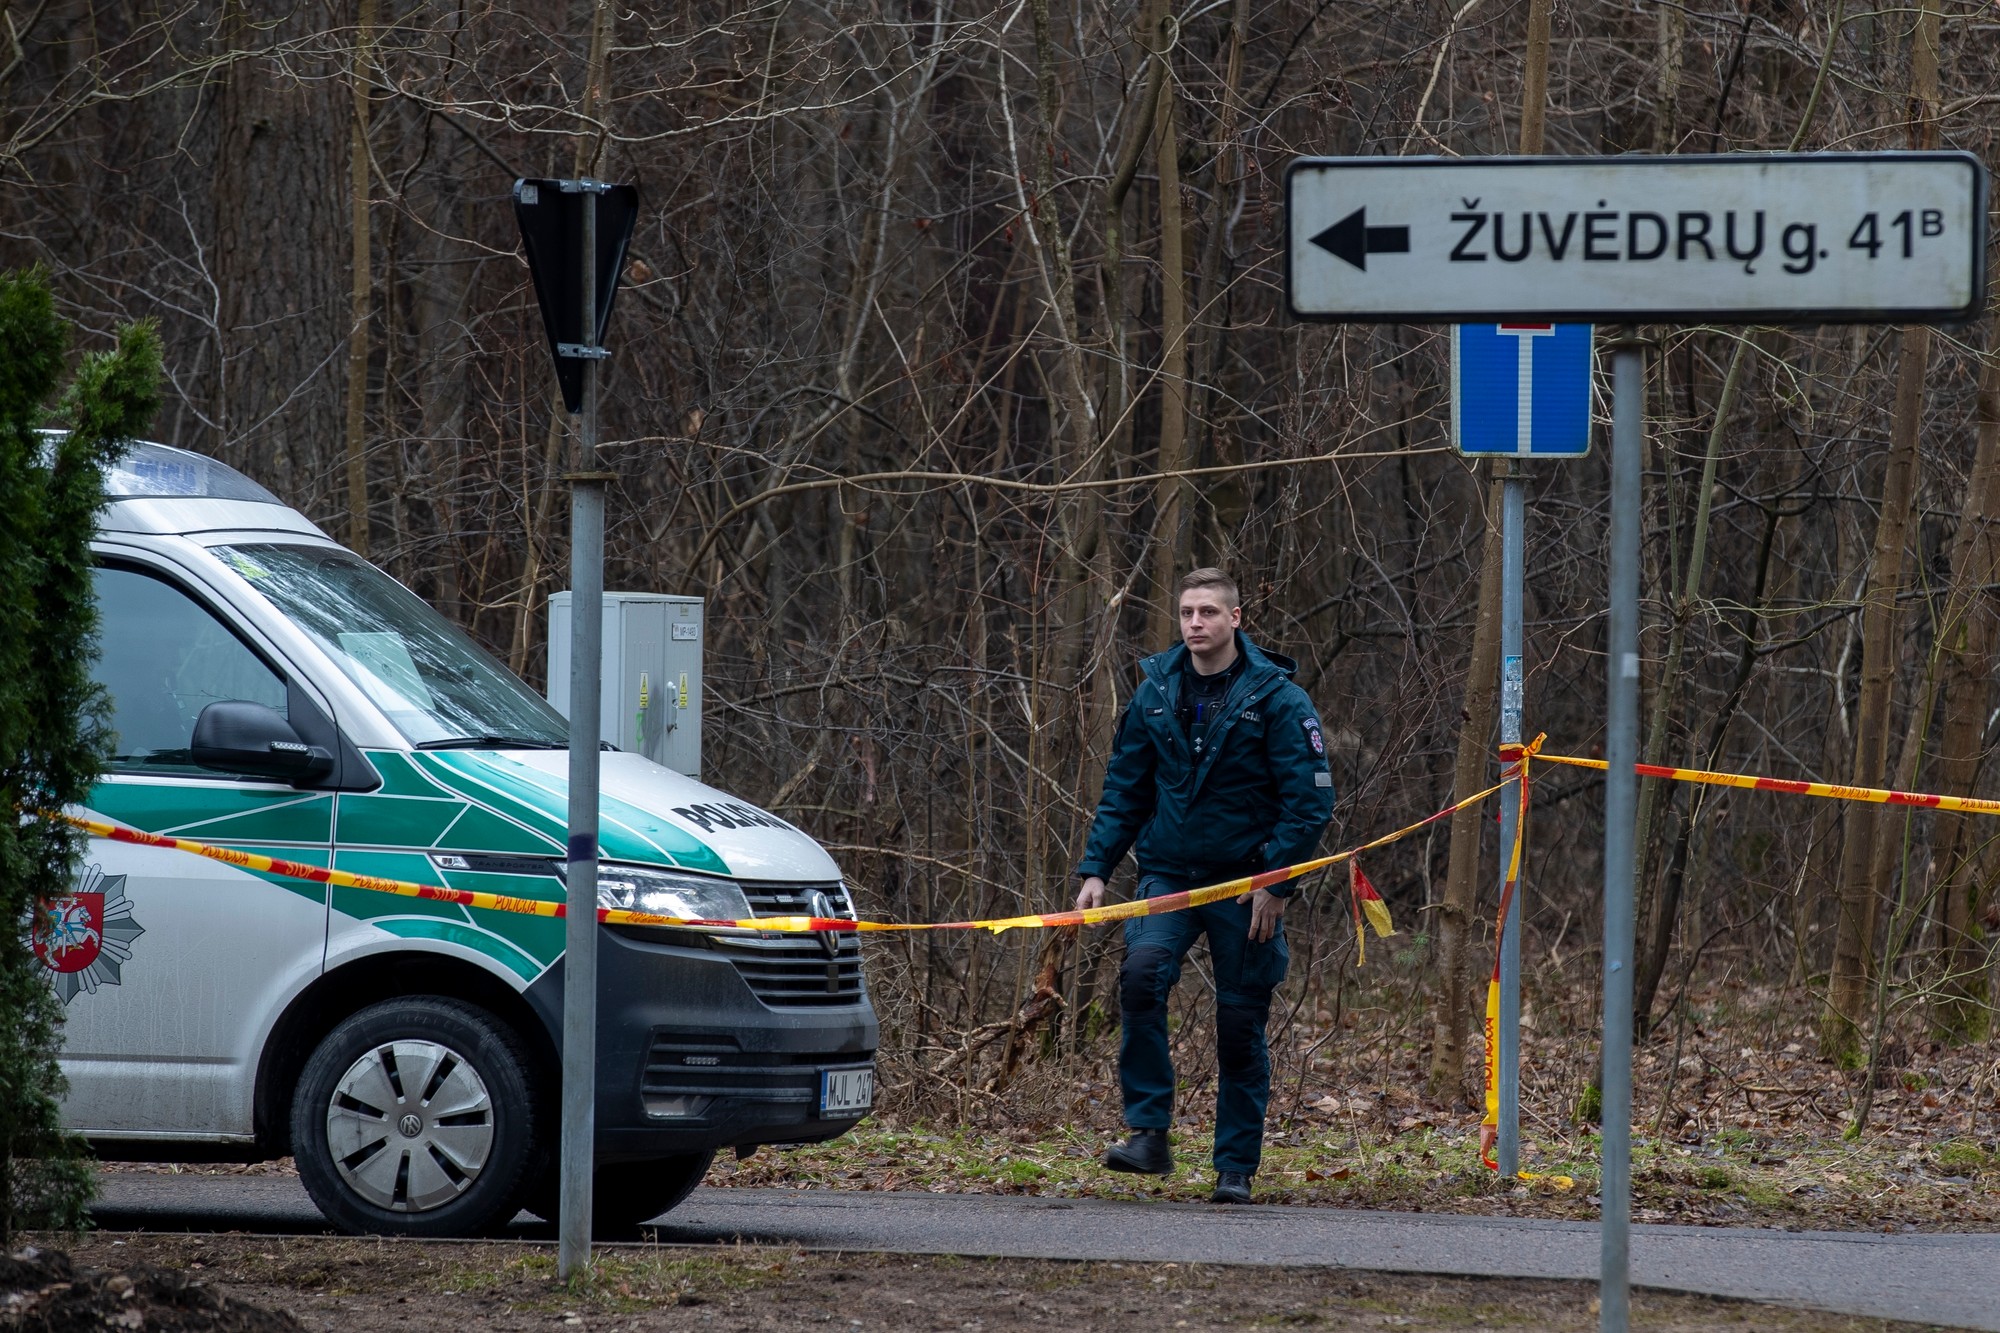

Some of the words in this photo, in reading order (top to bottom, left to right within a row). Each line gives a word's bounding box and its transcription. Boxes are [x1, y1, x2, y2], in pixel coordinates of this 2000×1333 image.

[1448, 197, 1765, 275] ŽUVĖDRŲ
[1780, 222, 1828, 274] g.
[285, 860, 316, 878] STOP
[431, 887, 460, 902] STOP
[493, 894, 537, 914] POLICIJA
[474, 861, 545, 870] TRANSPORTER
[828, 1075, 850, 1106] MJL
[855, 1072, 872, 1105] 247
